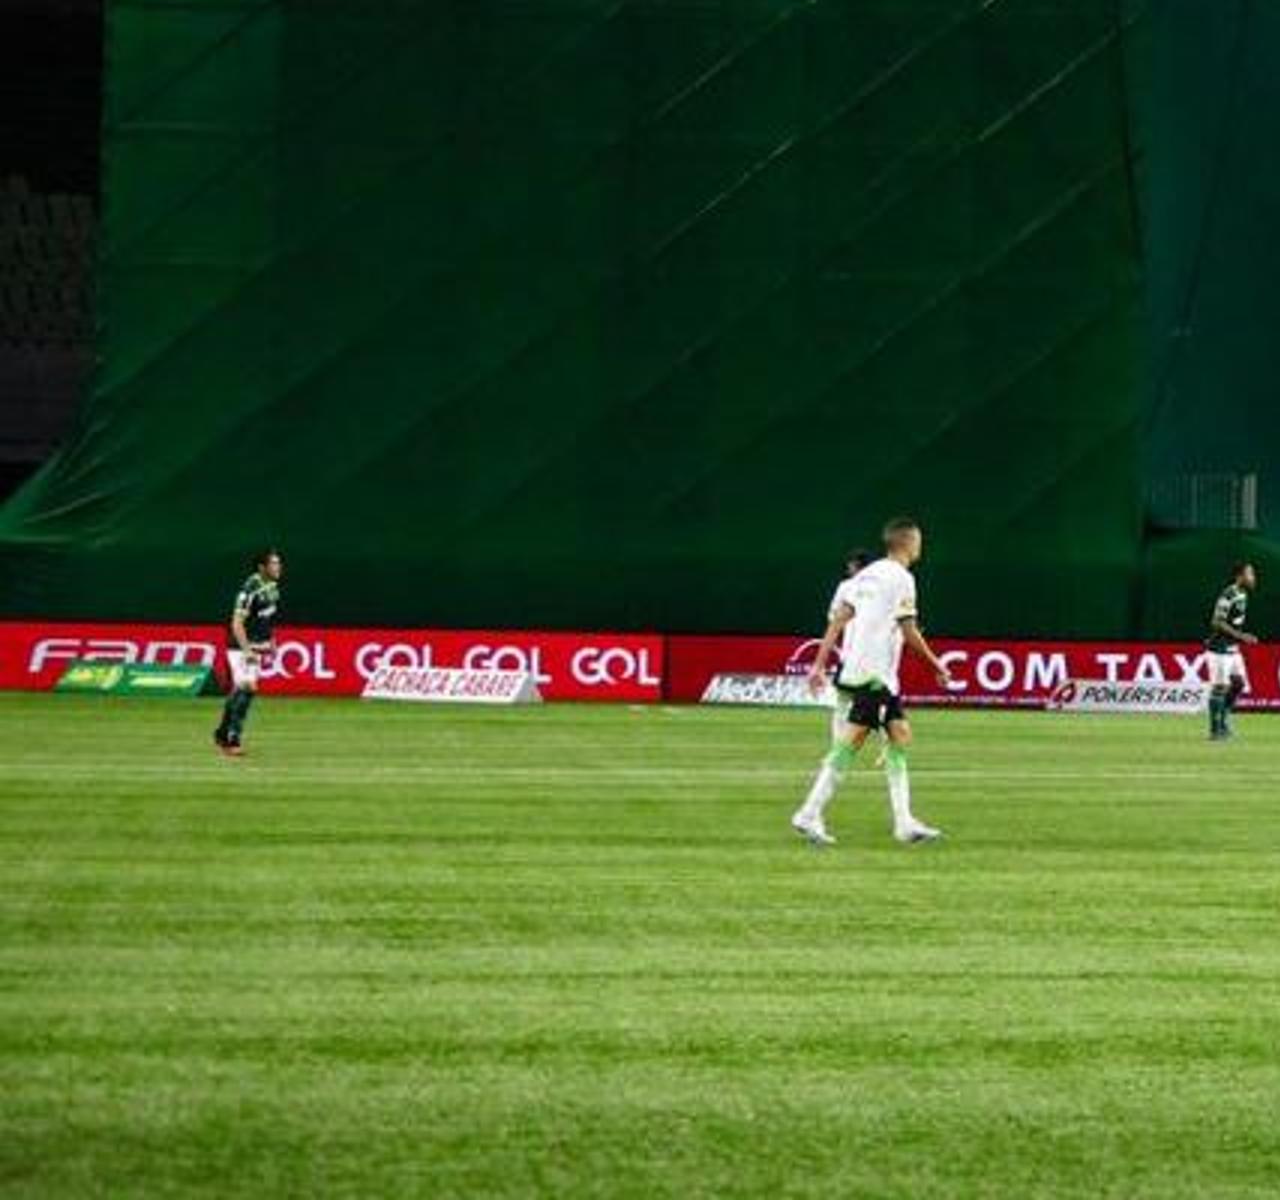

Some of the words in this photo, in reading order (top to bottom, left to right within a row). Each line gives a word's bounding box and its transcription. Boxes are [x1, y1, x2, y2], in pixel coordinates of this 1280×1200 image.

[464, 645, 552, 683] GOL
[572, 647, 660, 685] GOL
[938, 650, 1068, 691] COM
